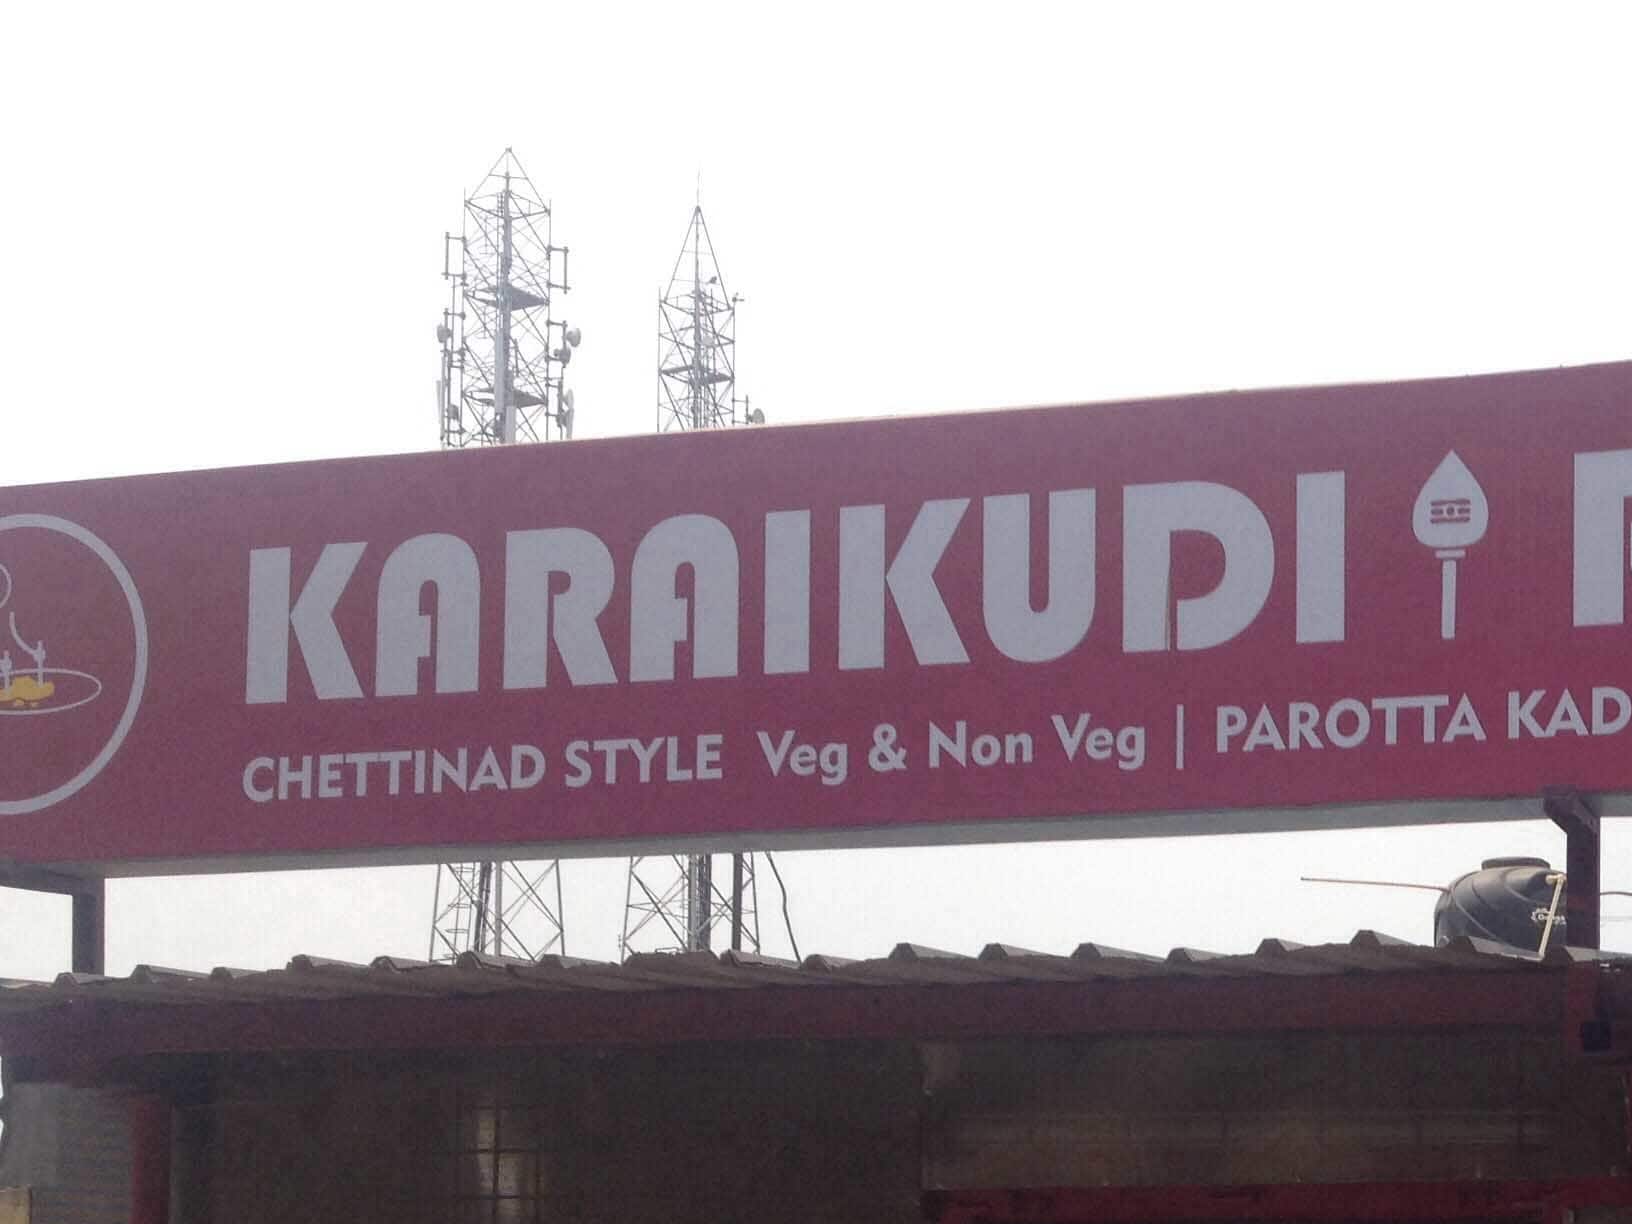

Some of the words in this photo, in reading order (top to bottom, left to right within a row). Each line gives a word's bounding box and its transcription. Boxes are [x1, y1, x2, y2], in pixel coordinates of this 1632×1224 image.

[245, 470, 1347, 705] KARAIKUDI
[243, 745, 545, 802] CHETTINAD
[565, 734, 723, 787] STYLE
[757, 730, 848, 785] Veg
[869, 724, 906, 772] &
[929, 720, 1032, 768] Non
[1052, 713, 1145, 770] Veg
[1217, 694, 1486, 752] PAROTTA
